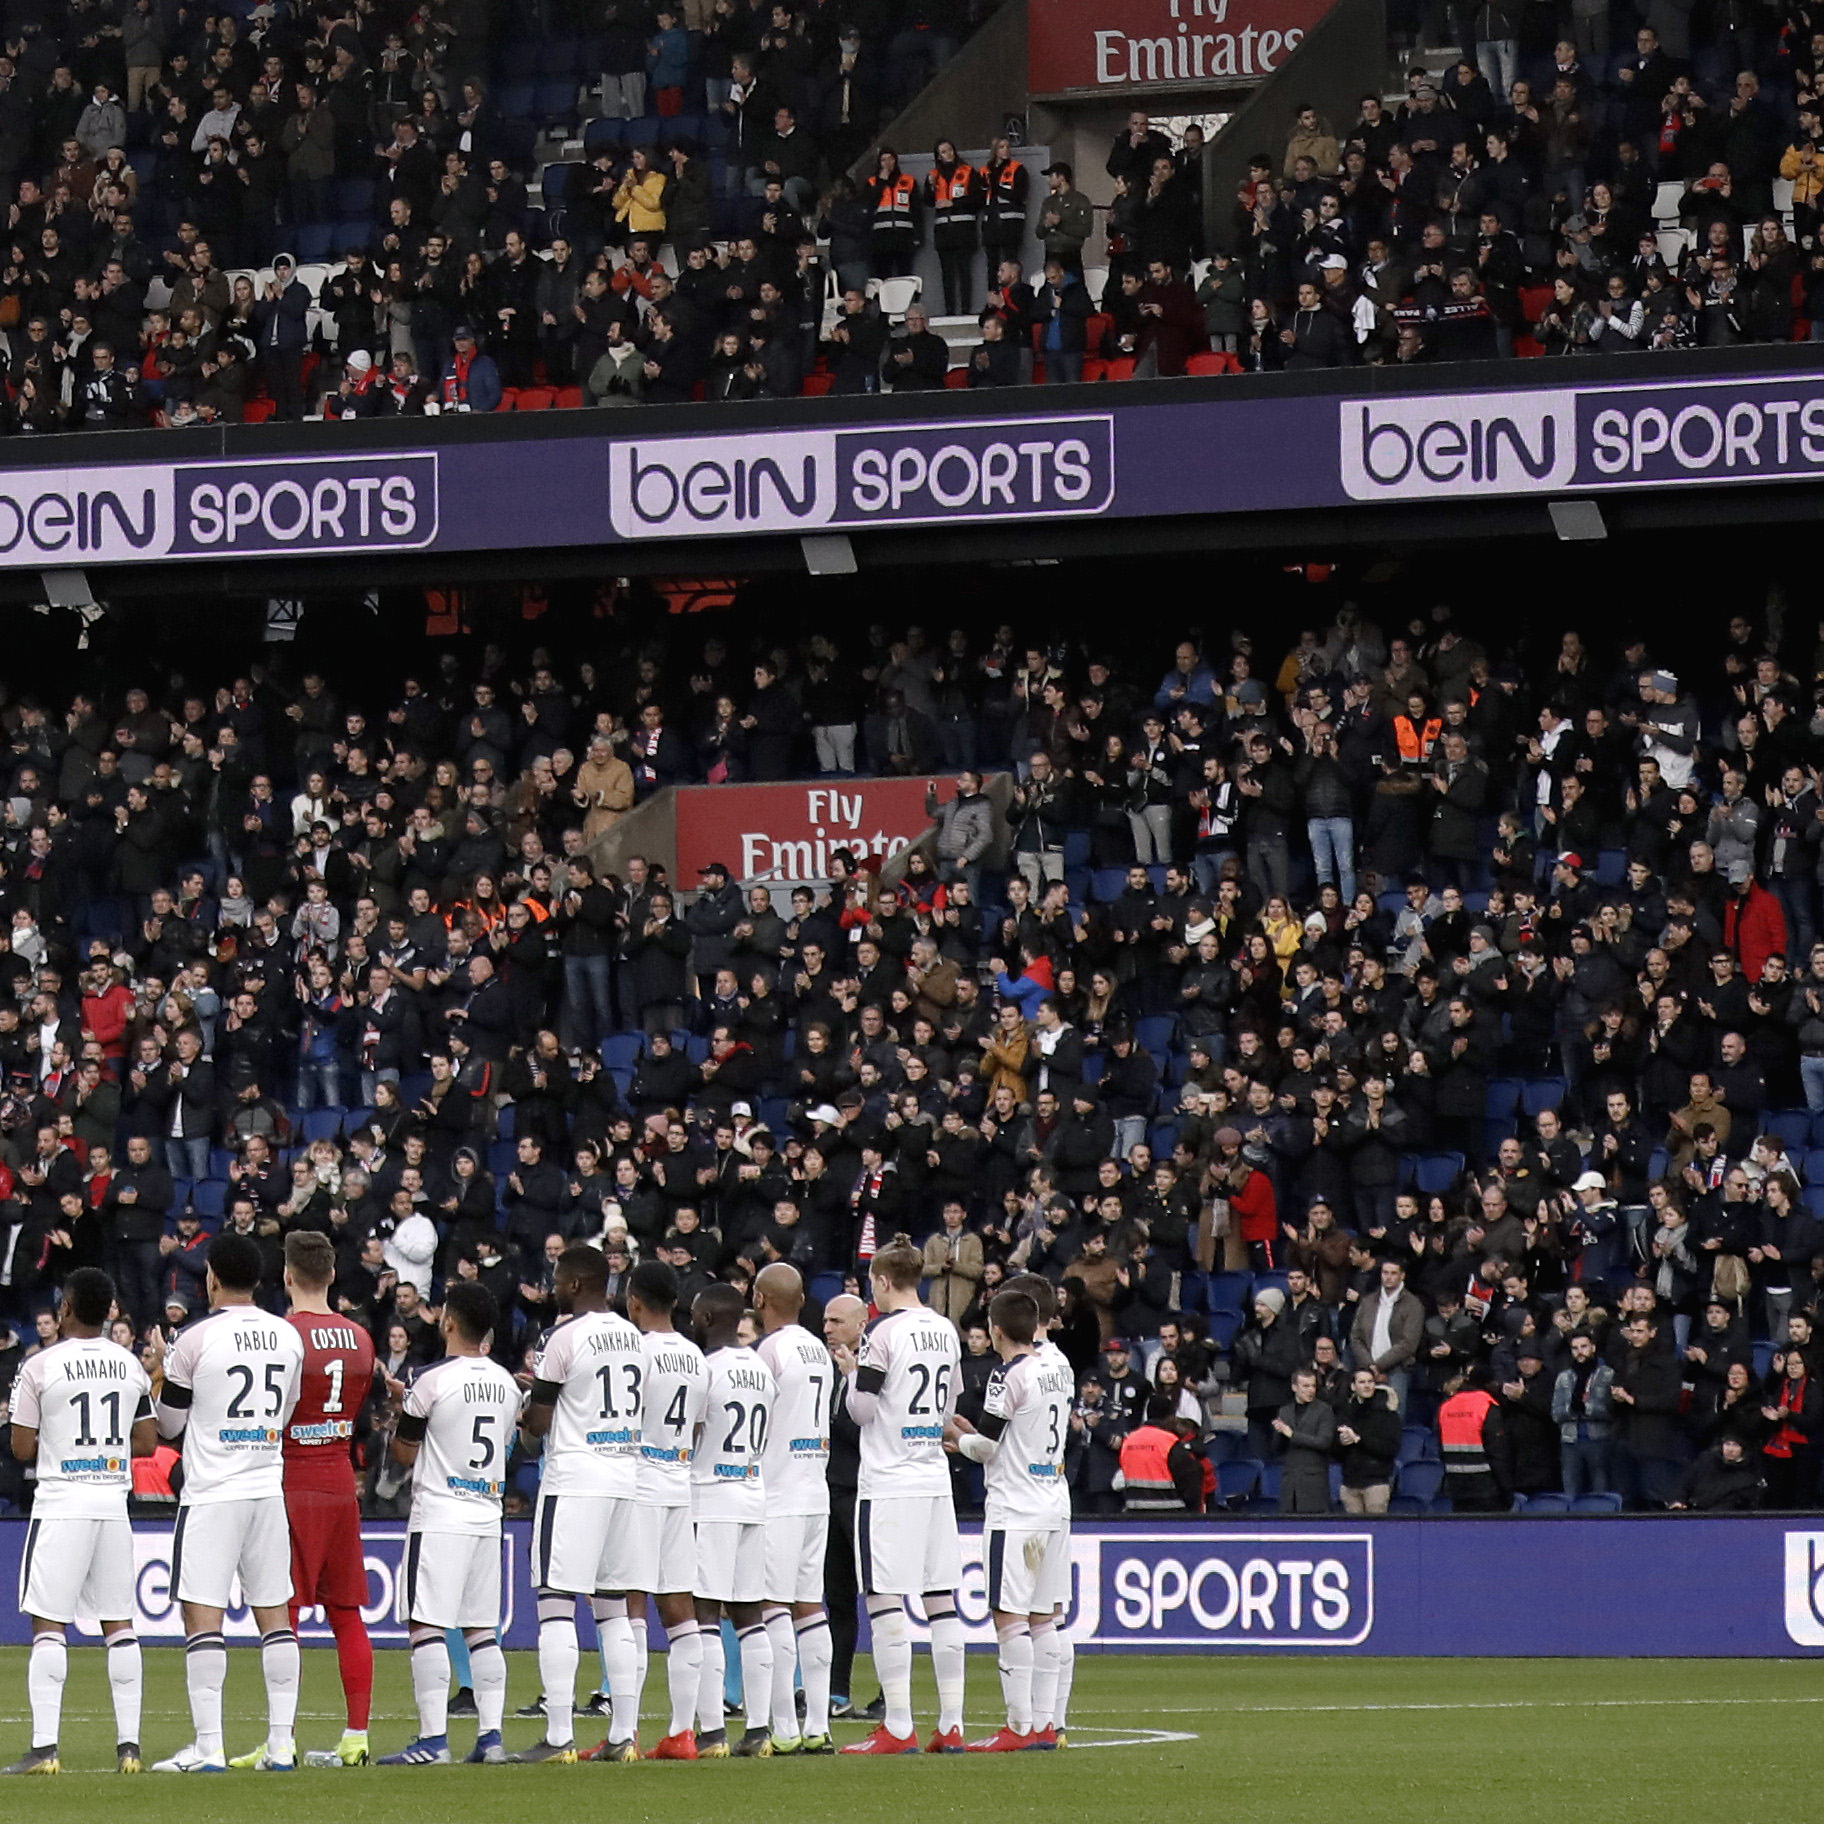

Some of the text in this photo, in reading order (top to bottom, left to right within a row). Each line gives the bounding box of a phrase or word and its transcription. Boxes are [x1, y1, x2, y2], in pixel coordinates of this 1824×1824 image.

[1362, 407, 1559, 486] beIN
[629, 439, 1093, 524] beIN SPORTS
[188, 475, 418, 546] SPORTS
[808, 789, 863, 829] Fly
[741, 828, 910, 881] Emiate
[233, 1330, 278, 1353] PABLO
[310, 1327, 358, 1351] COSTIL
[654, 1354, 700, 1376] KOUNDE
[63, 1359, 127, 1382] KAMANO
[225, 1363, 286, 1419] 25
[323, 1359, 344, 1413] 1
[463, 1377, 506, 1404] OTÁVIO
[595, 1363, 642, 1419] 13
[727, 1369, 767, 1393] SABALY
[908, 1363, 951, 1416] 26
[69, 1391, 125, 1447] 11
[663, 1384, 688, 1437] 4
[722, 1400, 768, 1456] 20
[809, 1375, 823, 1428] 7
[468, 1415, 496, 1470] 5
[1114, 1557, 1351, 1631] SPORTS
